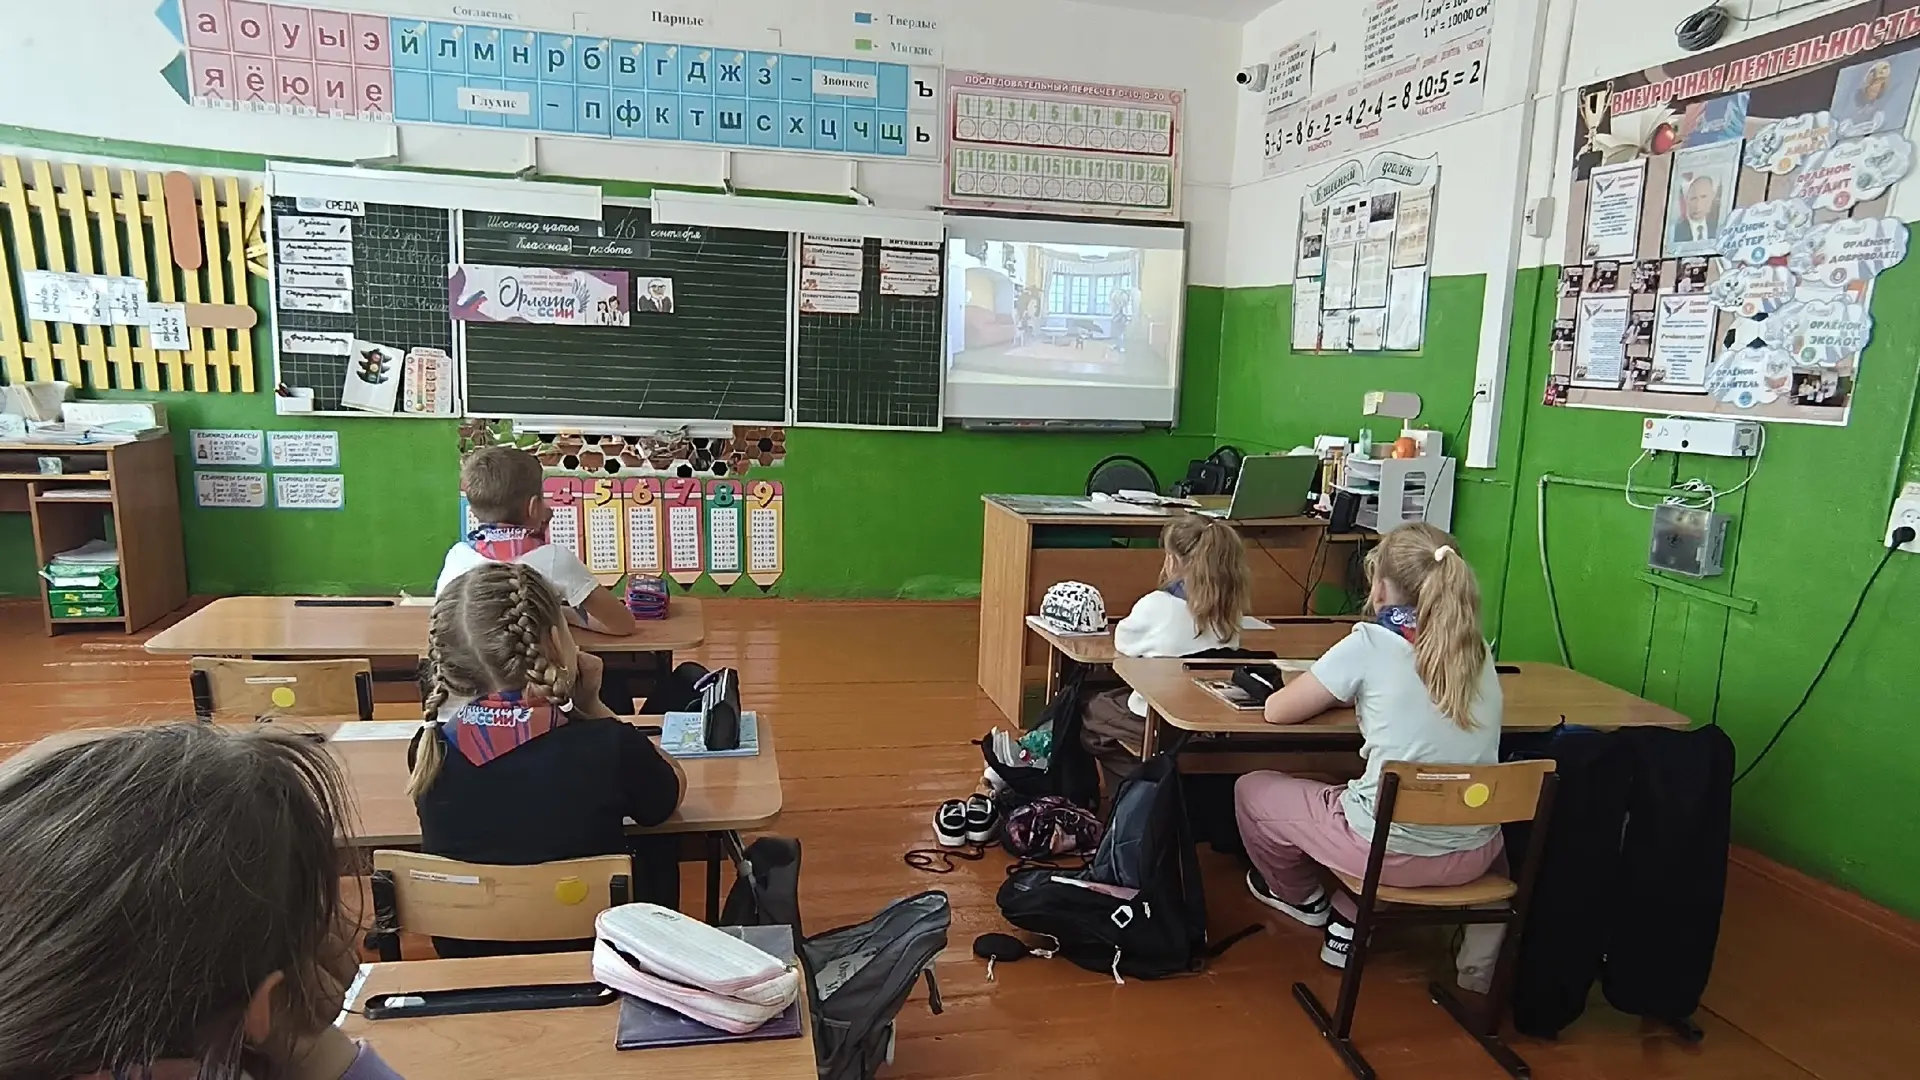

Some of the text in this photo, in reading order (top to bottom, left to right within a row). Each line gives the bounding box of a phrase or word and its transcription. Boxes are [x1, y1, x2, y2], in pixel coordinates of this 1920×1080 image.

[652, 10, 704, 27] Парные
[888, 14, 936, 29] Твердые
[1448, 8, 1474, 28] 10000
[198, 13, 380, 50] а о у ы э
[891, 42, 933, 55] Мягкие
[402, 29, 418, 54] й
[438, 39, 457, 57] л
[474, 43, 495, 61] м
[512, 47, 528, 64] н
[549, 49, 565, 72] р
[584, 47, 601, 70] б
[620, 56, 636, 73] в
[657, 58, 668, 75] г
[687, 62, 706, 83] д
[720, 64, 741, 82] ж
[821, 75, 869, 89] Звонкие
[914, 81, 934, 98] ъ
[1611, 6, 1920, 116] ВНЕУРОЧНАЯ ДЕЯТЕЛЬНОСТЬ
[205, 65, 382, 101] я ё ю и е
[965, 75, 1068, 92] ПОСЛЕДОВАТЕЛЬНЫЙ
[1071, 85, 1116, 97] ПЕРЕСЧЕТ
[471, 94, 517, 110] Глухие
[617, 100, 641, 127] ф
[657, 107, 669, 124] к
[690, 109, 704, 126] т
[719, 111, 742, 130] ш
[757, 114, 771, 132] с
[790, 116, 804, 133] х
[821, 118, 836, 140] ц
[854, 120, 868, 138] ч
[882, 124, 903, 145] щ
[916, 127, 930, 143] ь
[326, 200, 359, 212] СРЕДА
[499, 276, 575, 311] Орлята
[1809, 336, 1861, 347] ЭКОЛОГ
[552, 479, 775, 508] 4 5 6 7 8 9
[1328, 939, 1350, 951] NIKE
